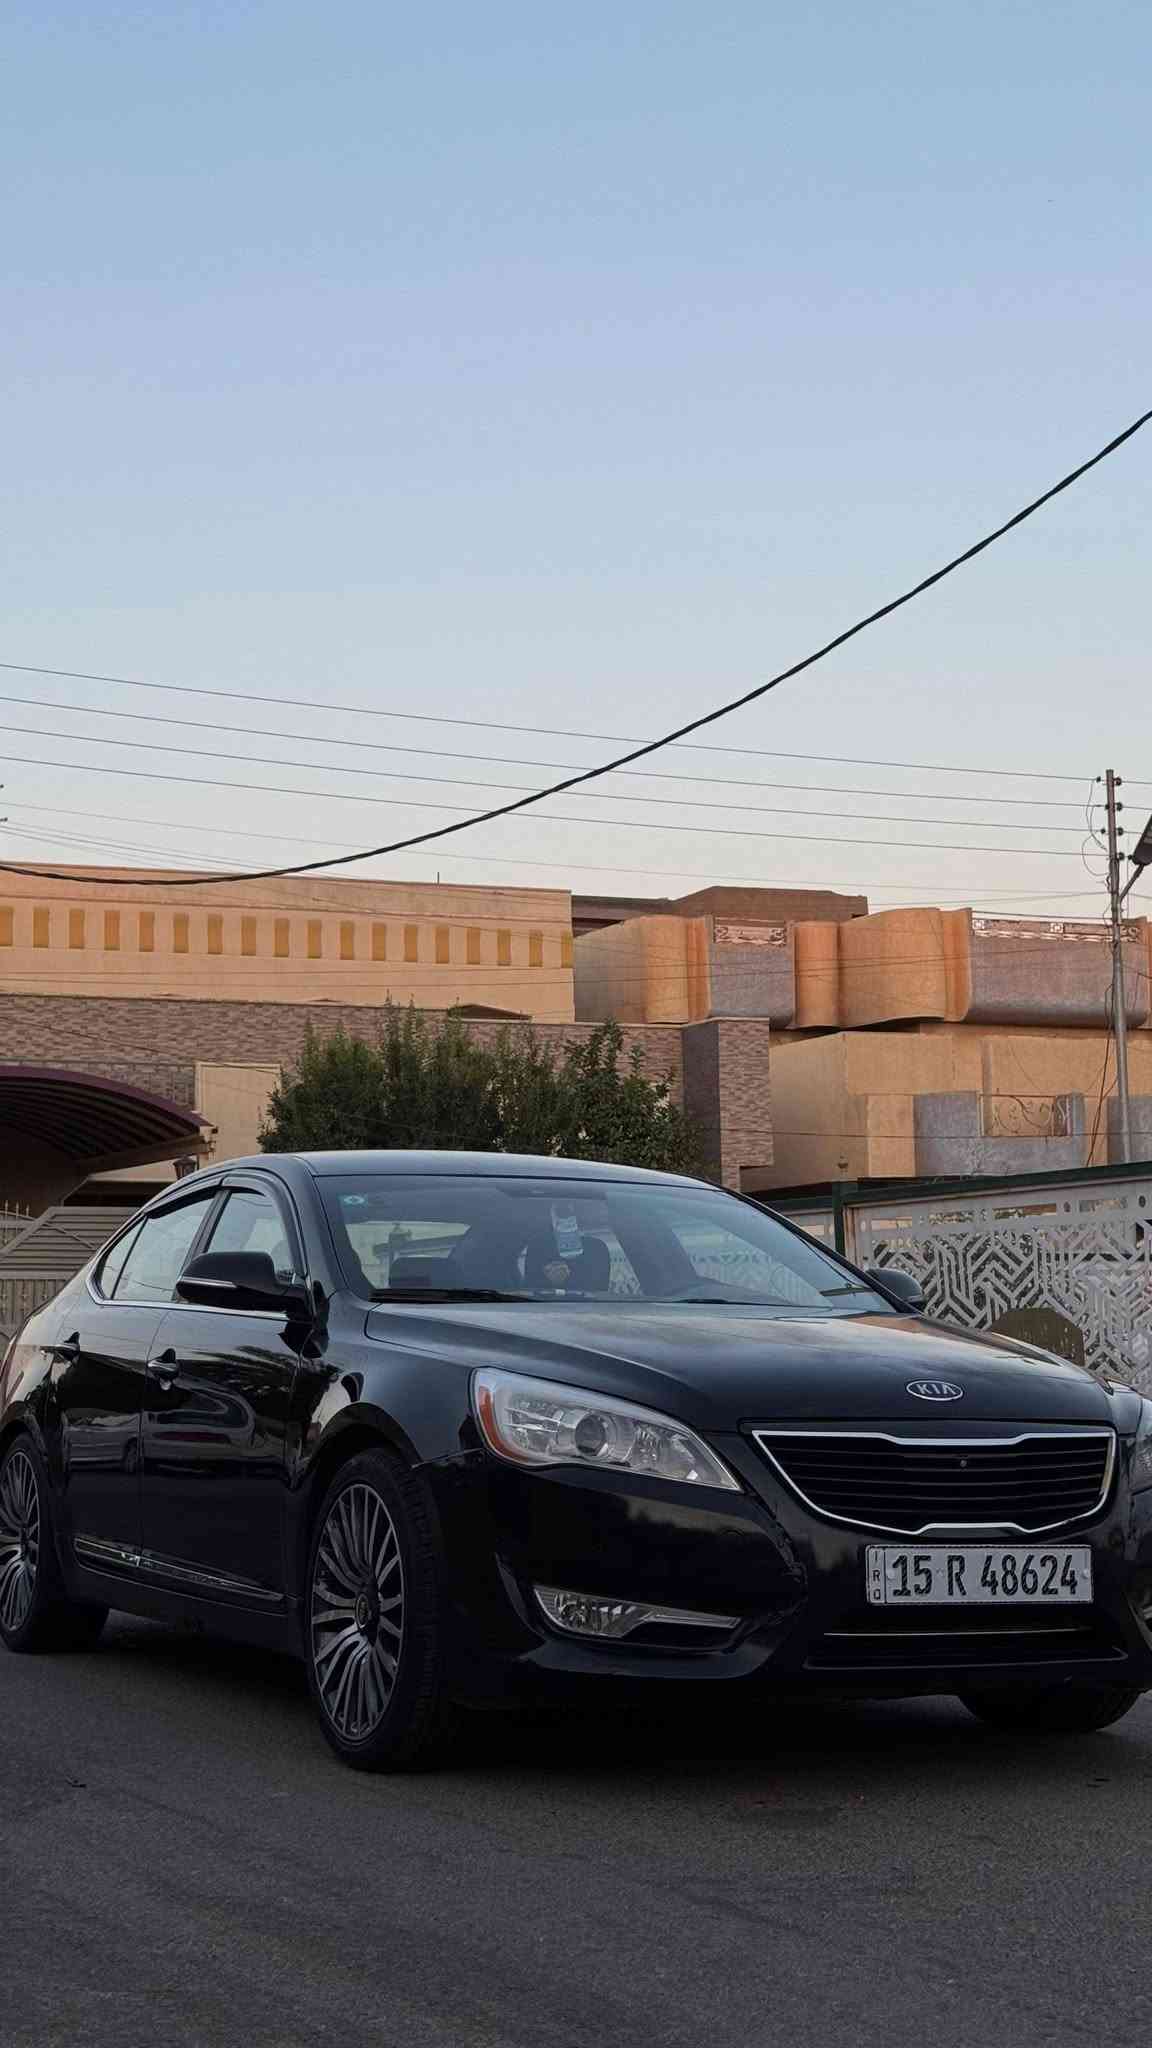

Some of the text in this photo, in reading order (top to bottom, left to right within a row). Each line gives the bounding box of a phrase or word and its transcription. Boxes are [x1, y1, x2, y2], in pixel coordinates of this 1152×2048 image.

[914, 1382, 958, 1396] KIA
[892, 1554, 1078, 1597] 15 R 48624
